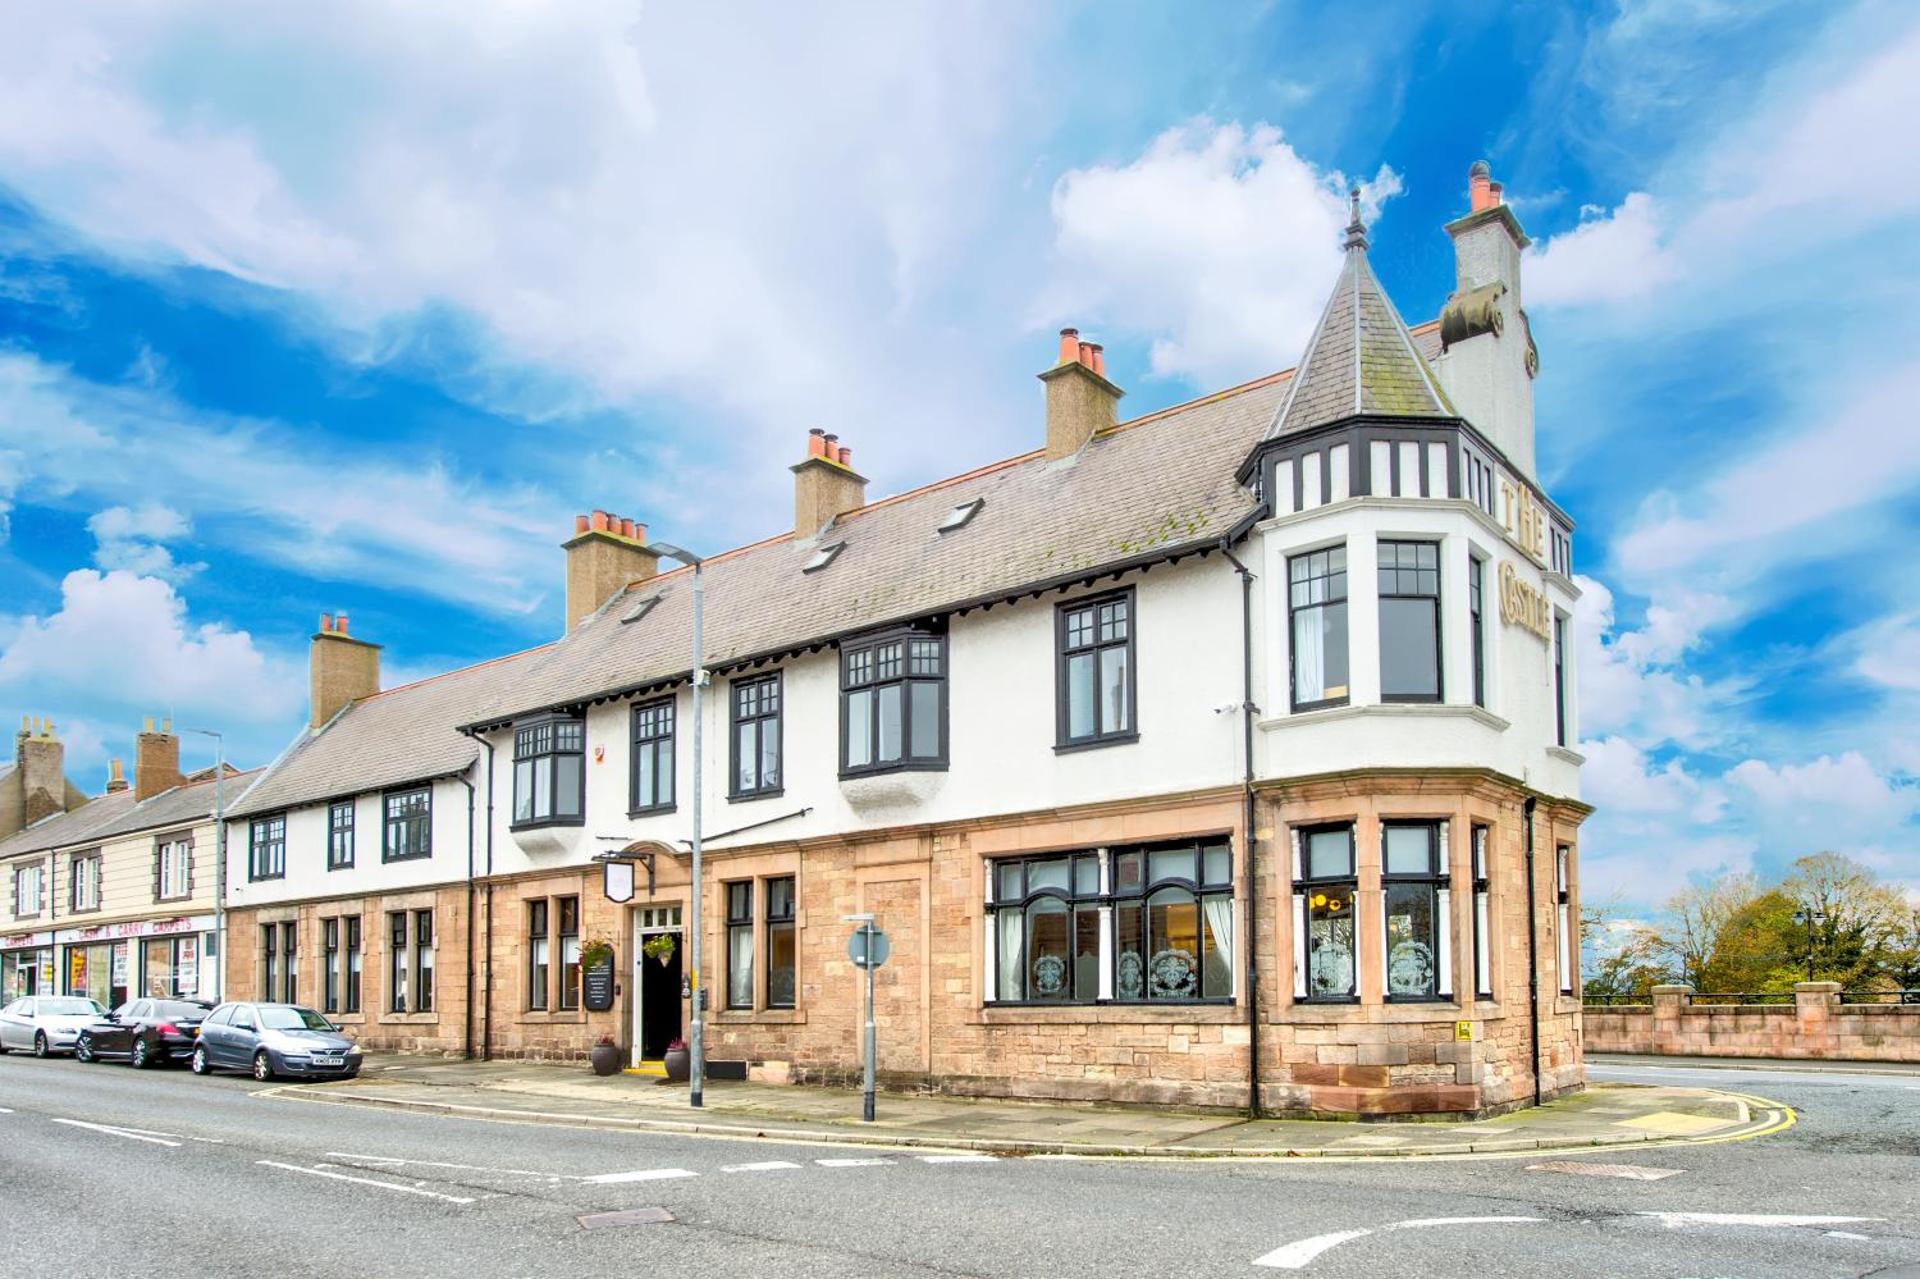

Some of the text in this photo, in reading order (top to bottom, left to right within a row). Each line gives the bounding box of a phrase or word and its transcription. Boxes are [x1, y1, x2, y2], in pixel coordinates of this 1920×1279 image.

[1502, 481, 1544, 558] THE
[79, 917, 192, 940] CASH & CARRY CARPETS
